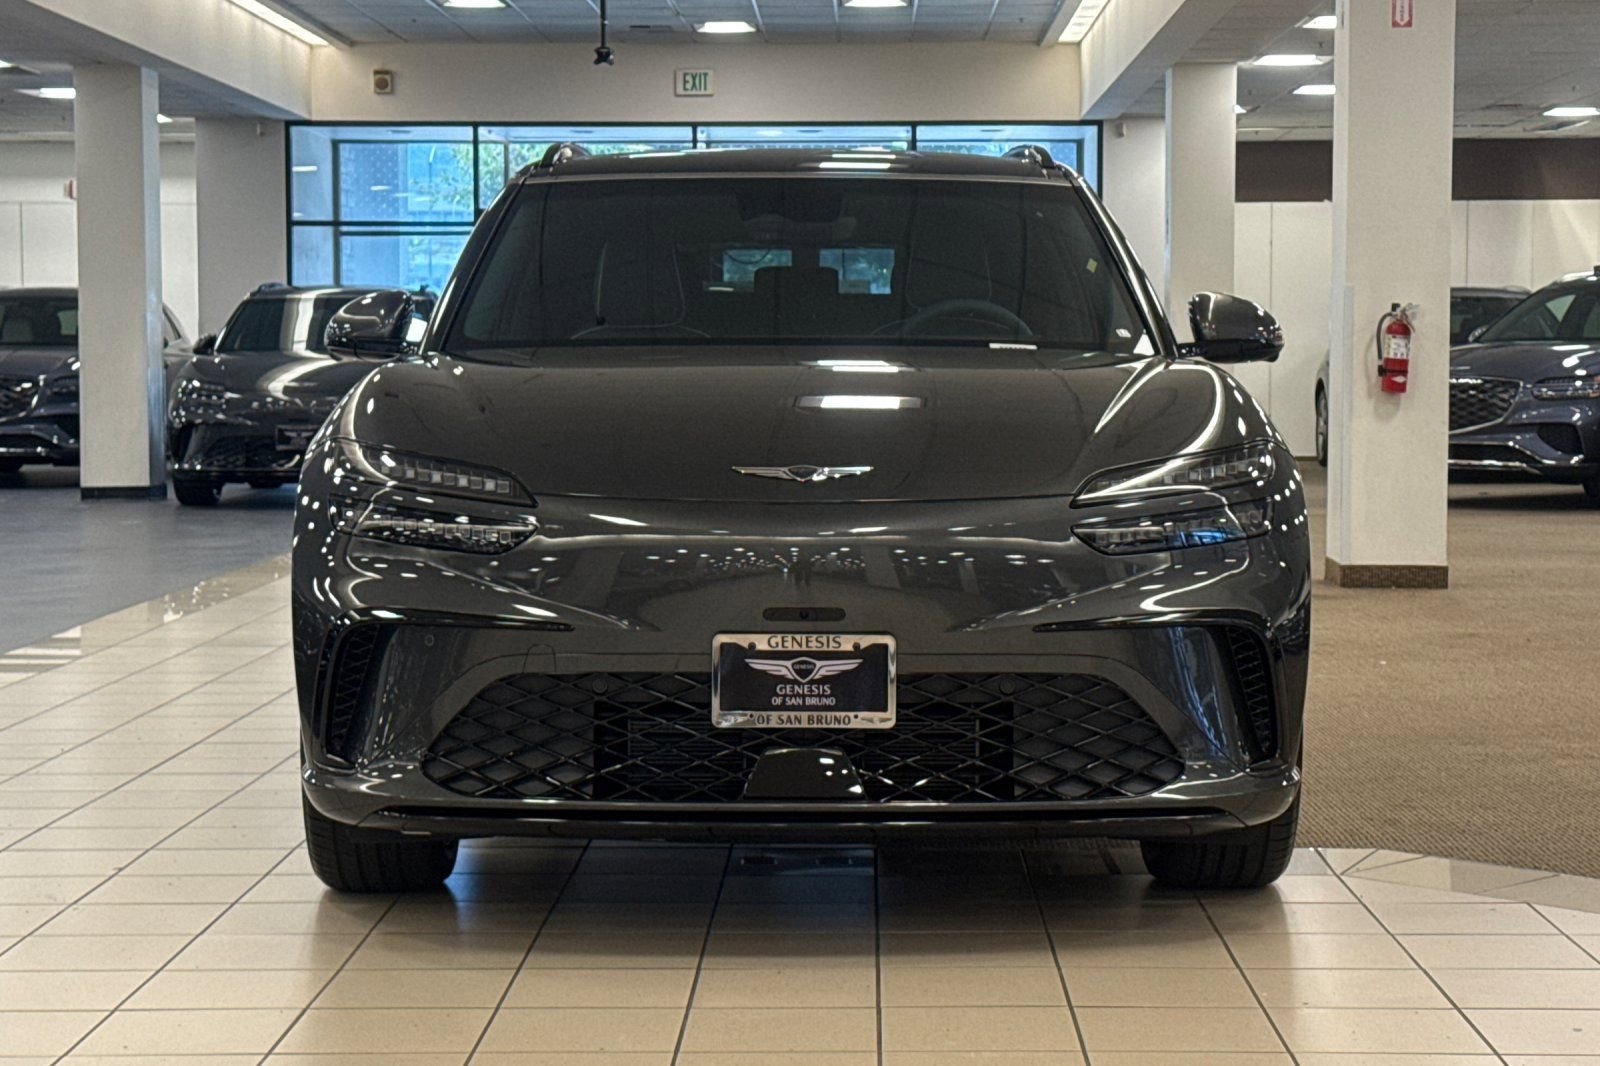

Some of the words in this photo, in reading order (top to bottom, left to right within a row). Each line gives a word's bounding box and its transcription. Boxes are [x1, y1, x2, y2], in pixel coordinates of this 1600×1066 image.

[683, 72, 708, 91] EXIT
[767, 635, 842, 649] GENESIS
[776, 684, 831, 695] GENESIS
[771, 697, 783, 706] OF
[785, 697, 803, 706] SAN
[805, 697, 836, 706] BRUNO
[756, 714, 773, 726] OF
[777, 714, 802, 726] SAN
[807, 714, 851, 726] BRUNO
